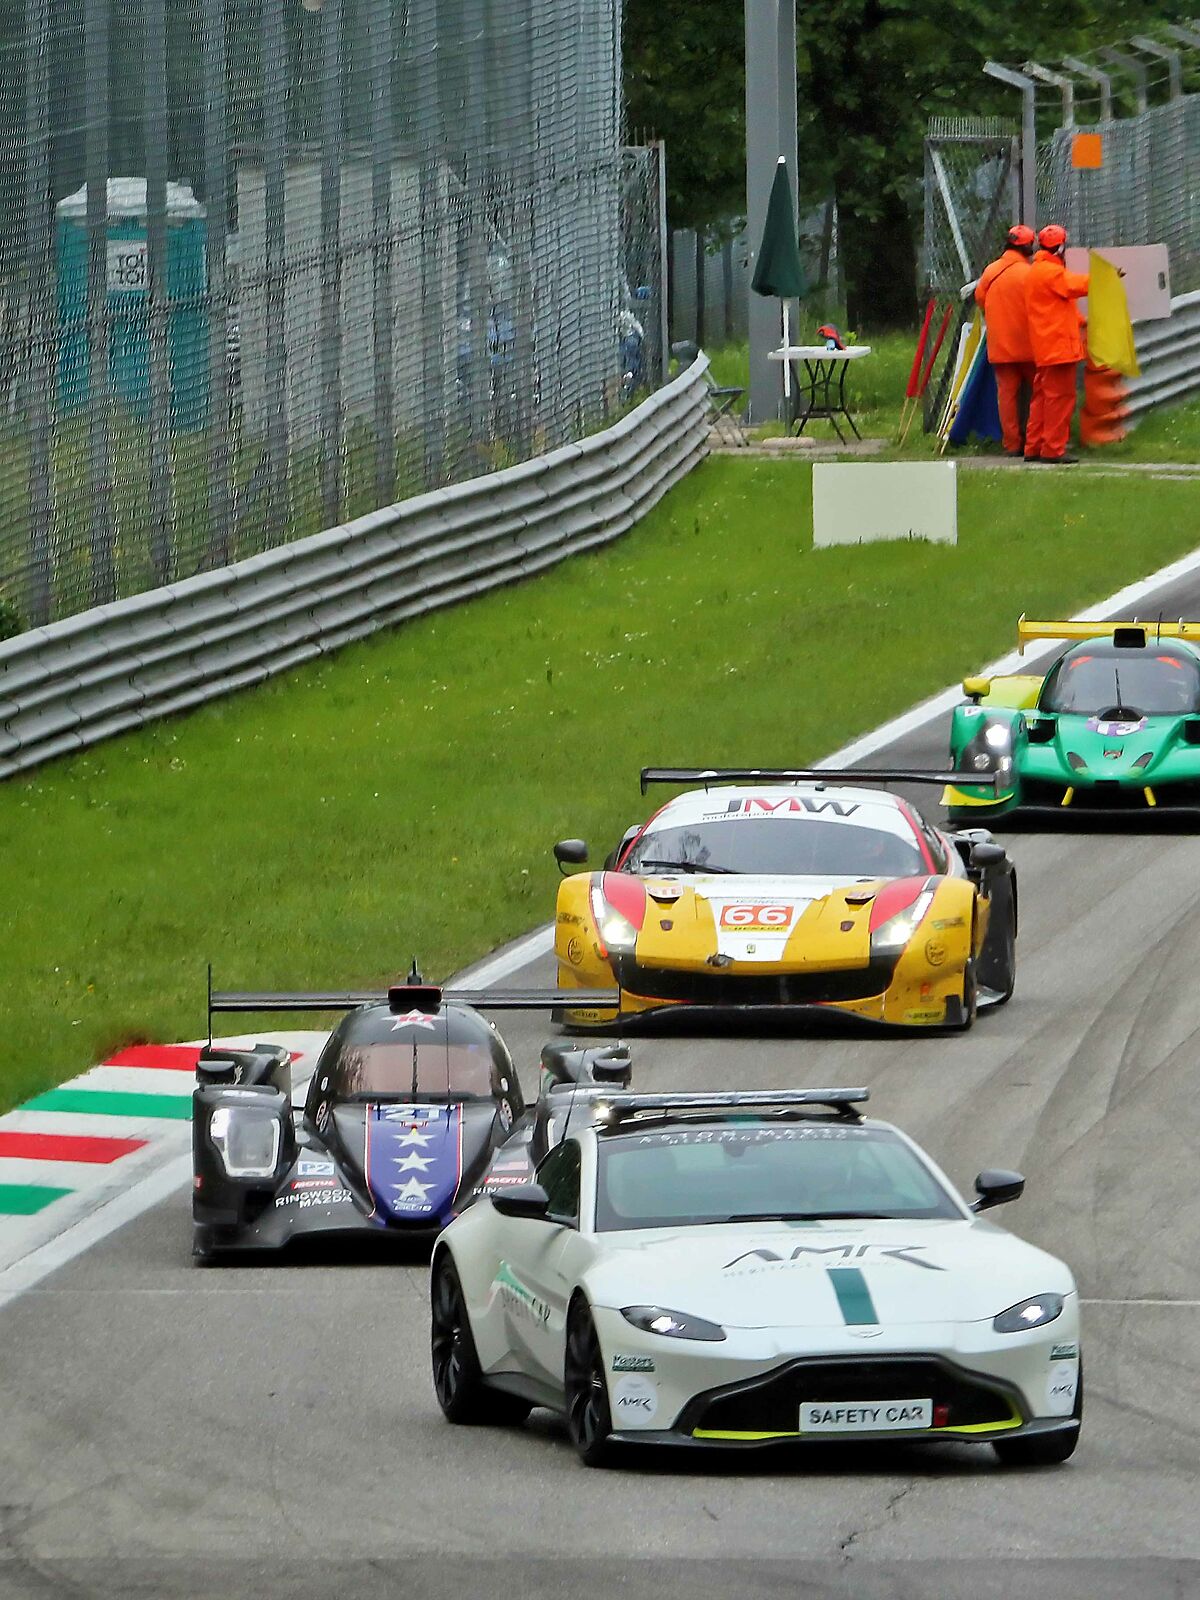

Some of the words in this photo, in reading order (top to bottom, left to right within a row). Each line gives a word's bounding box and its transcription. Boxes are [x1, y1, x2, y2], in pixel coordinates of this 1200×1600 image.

[703, 797, 861, 818] JMW
[724, 905, 787, 925] 66
[301, 1162, 330, 1172] P2
[293, 1180, 335, 1189] MOTUL
[275, 1189, 352, 1208] RINGWOOD
[300, 1196, 353, 1209] MAZDA
[809, 1408, 880, 1424] SAFETY
[885, 1405, 923, 1422] CAR
